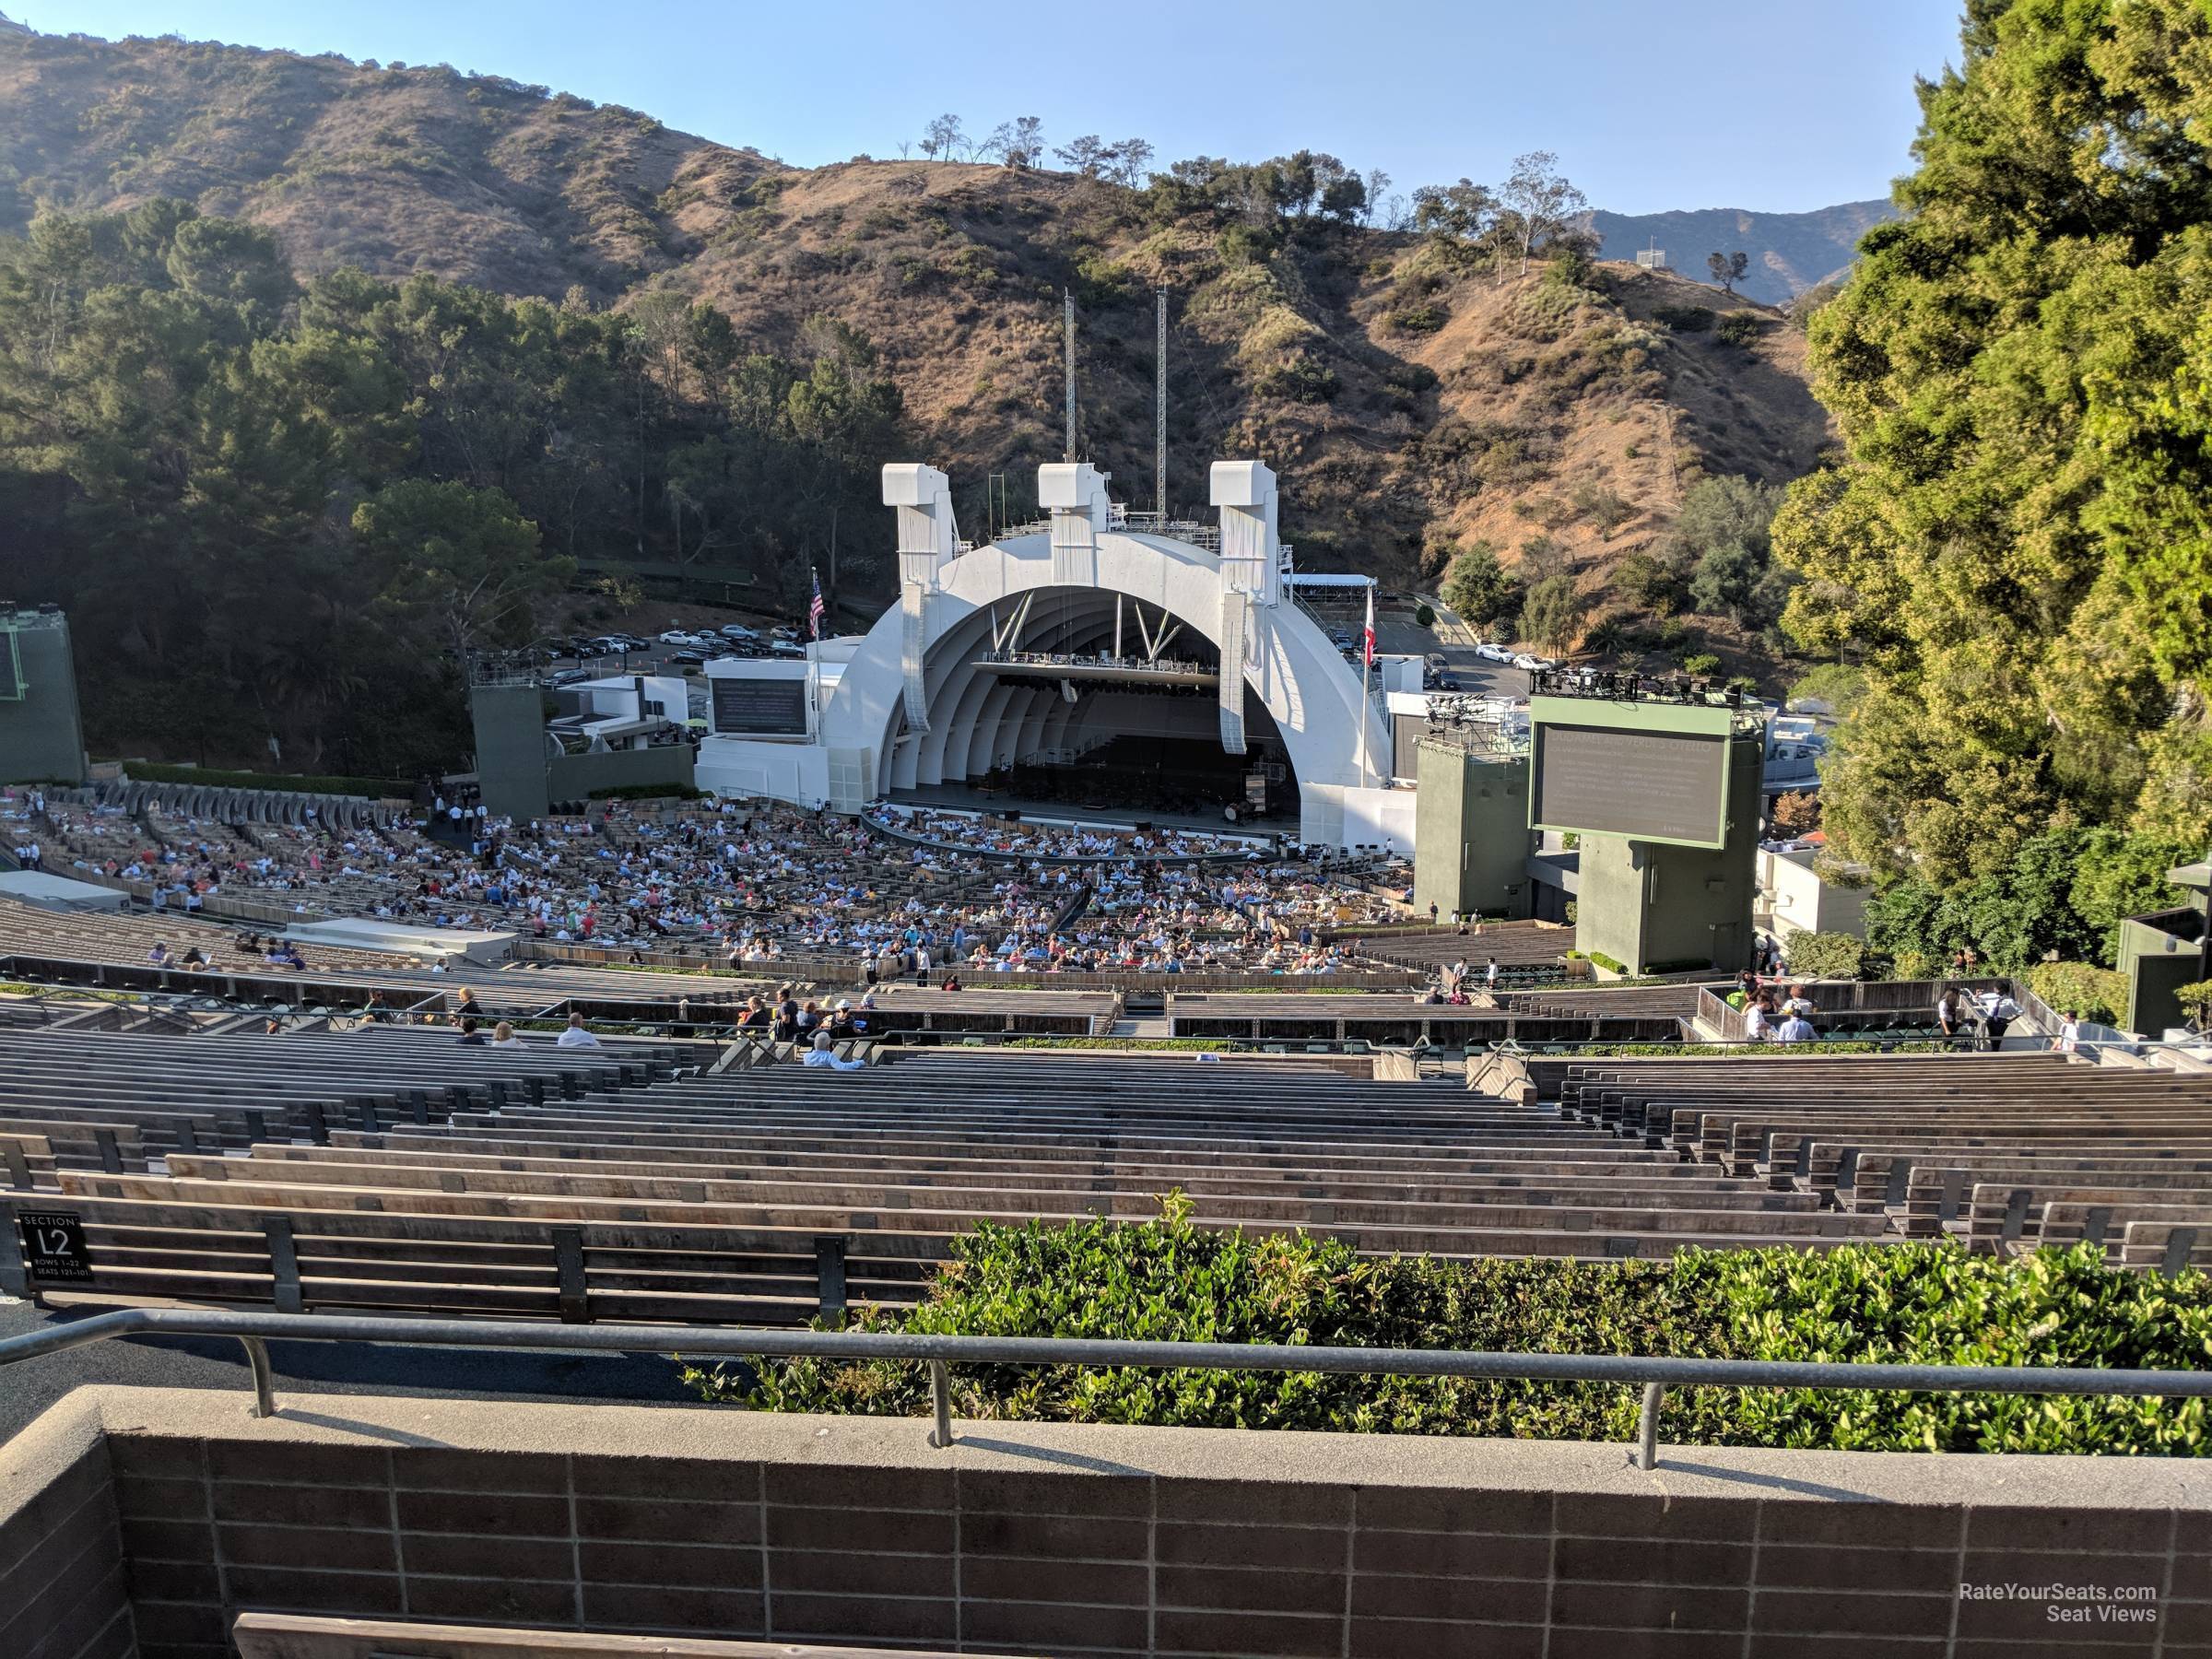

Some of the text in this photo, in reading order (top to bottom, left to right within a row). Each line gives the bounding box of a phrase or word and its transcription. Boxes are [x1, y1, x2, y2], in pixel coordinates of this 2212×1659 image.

[24, 1216, 75, 1226] SECTION
[37, 1229, 73, 1255] L2
[35, 1258, 79, 1267] ROWS 1-22
